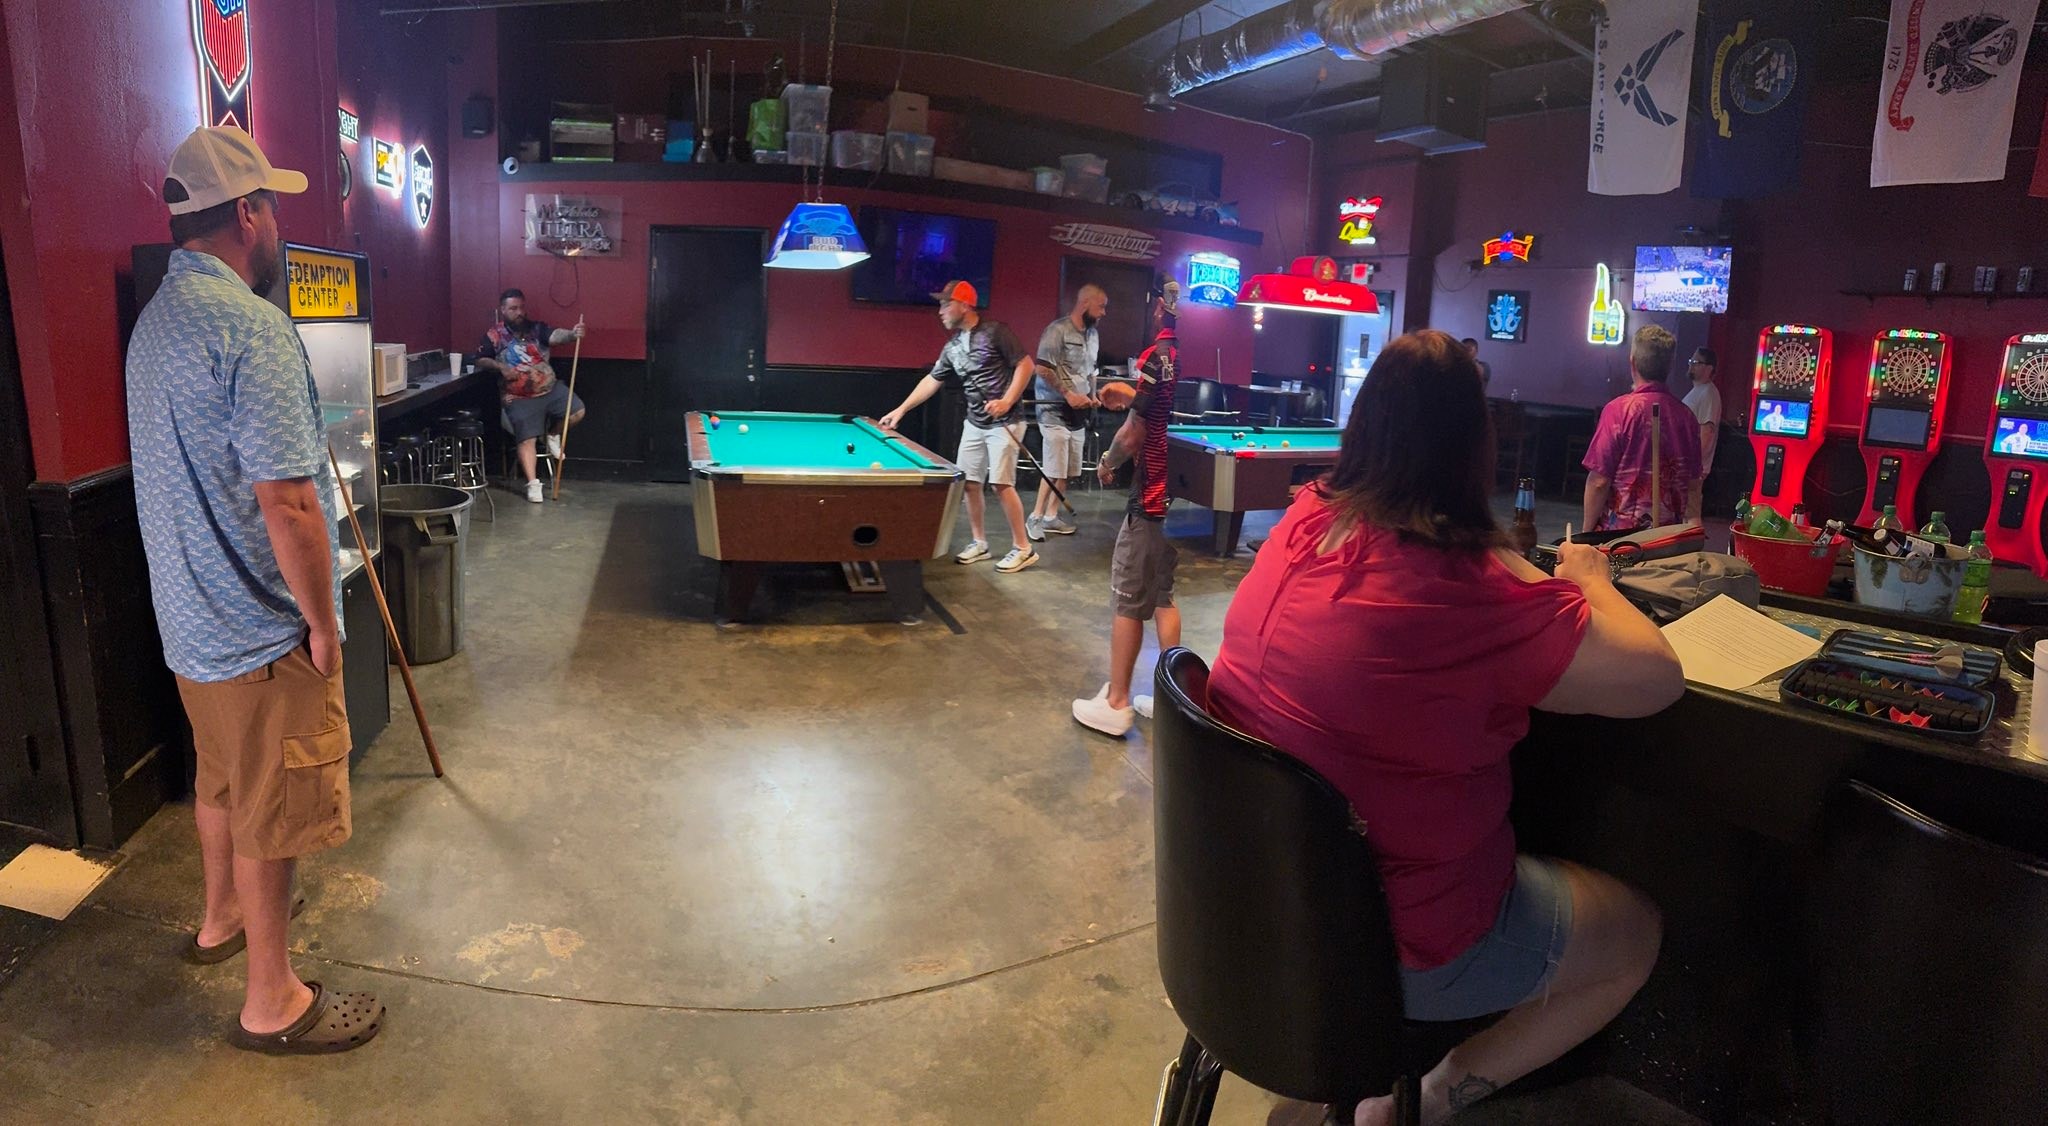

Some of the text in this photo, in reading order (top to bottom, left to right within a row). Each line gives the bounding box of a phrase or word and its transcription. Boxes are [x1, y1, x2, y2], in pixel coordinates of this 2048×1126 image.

[1887, 46, 1901, 71] 1775
[1593, 98, 1606, 154] ORCE
[539, 220, 607, 238] ULTRA
[812, 236, 839, 246] BUD
[298, 286, 340, 309] CENTER
